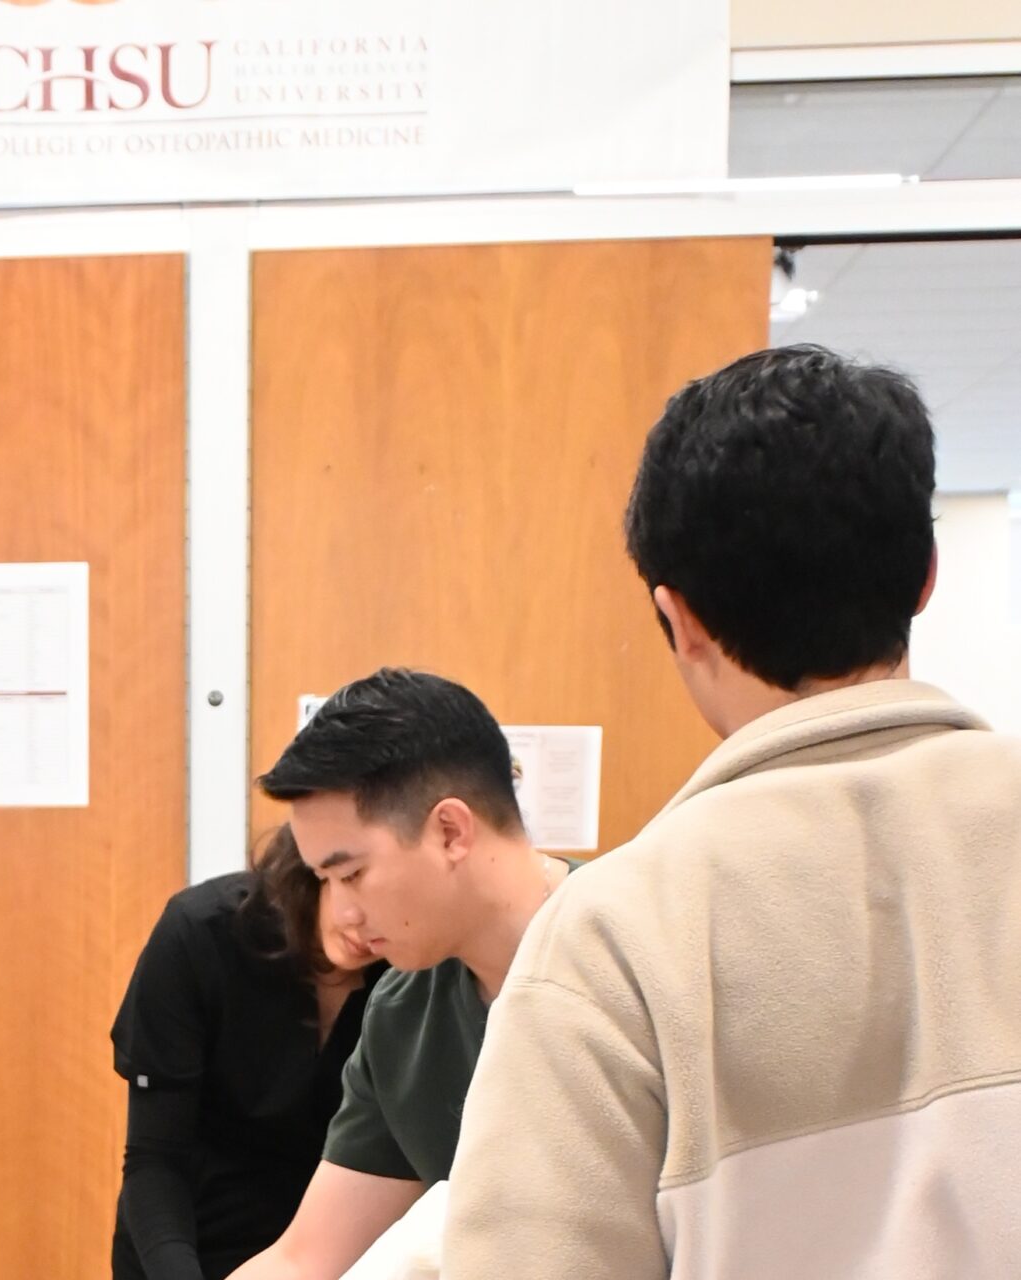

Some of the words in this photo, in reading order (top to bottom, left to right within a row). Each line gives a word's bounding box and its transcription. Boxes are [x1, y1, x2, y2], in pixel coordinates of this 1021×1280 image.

[233, 35, 428, 57] CALIFORNIA
[233, 81, 428, 103] UNIVERSITY
[86, 134, 118, 155] OF
[125, 129, 293, 154] OSTEOPATHIC
[299, 125, 426, 148] MEDICINE
